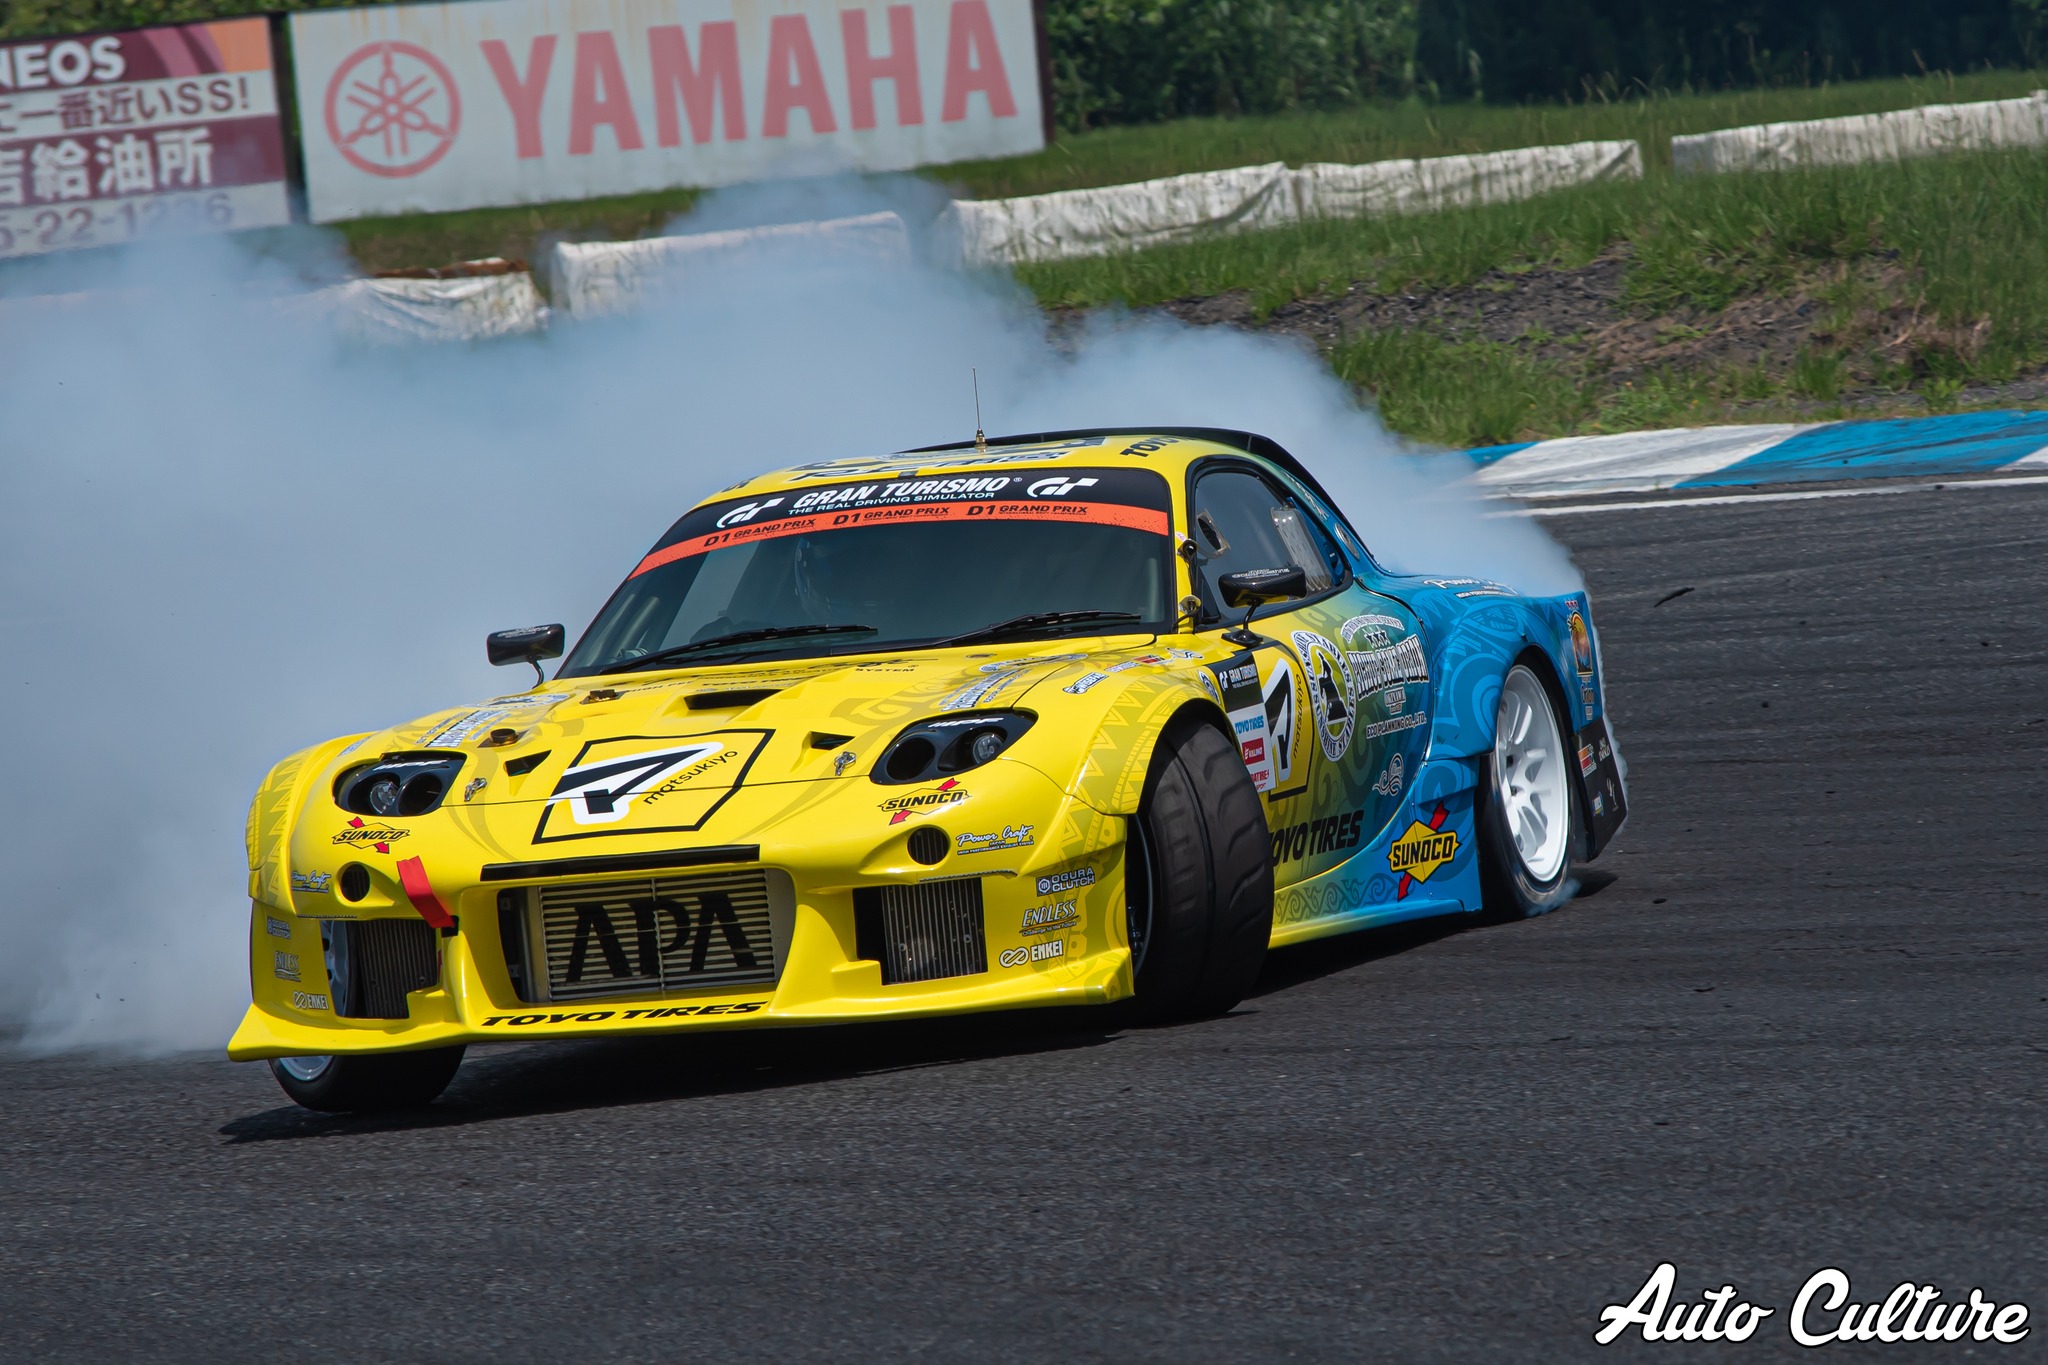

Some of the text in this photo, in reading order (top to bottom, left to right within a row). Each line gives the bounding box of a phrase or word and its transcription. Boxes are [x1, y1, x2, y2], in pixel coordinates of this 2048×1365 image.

[480, 0, 1018, 159] YAMAHA
[788, 492, 995, 516] THE REAL DRIVING SIMULATOR
[793, 485, 878, 509] GRAN
[880, 476, 1011, 498] TURISMO
[703, 532, 731, 547] D1
[733, 523, 781, 538] GRAND
[782, 518, 817, 530] PRIX
[833, 513, 861, 526] D1
[864, 508, 914, 519] GRAND
[915, 506, 951, 516] PRIX
[966, 505, 996, 516] D1
[1052, 505, 1088, 513] PRIX
[1235, 719, 1249, 734] TOYO
[1293, 673, 1304, 759] matsukiyo
[643, 750, 739, 805] matsukiyo
[886, 791, 964, 810] SUNOCO
[337, 829, 408, 842] SUNOCO
[957, 824, 1034, 847] Power Craft
[1269, 810, 1364, 867] OYO TIRES
[1393, 835, 1454, 869] SUNOCO
[1050, 867, 1094, 884] OGURA
[1051, 876, 1095, 893] CLUTCH
[1022, 899, 1076, 928] ENDLESS
[1030, 939, 1063, 962] ENKEI
[307, 994, 329, 1009] ENKEI
[481, 1001, 769, 1027] TOYO TIRES
